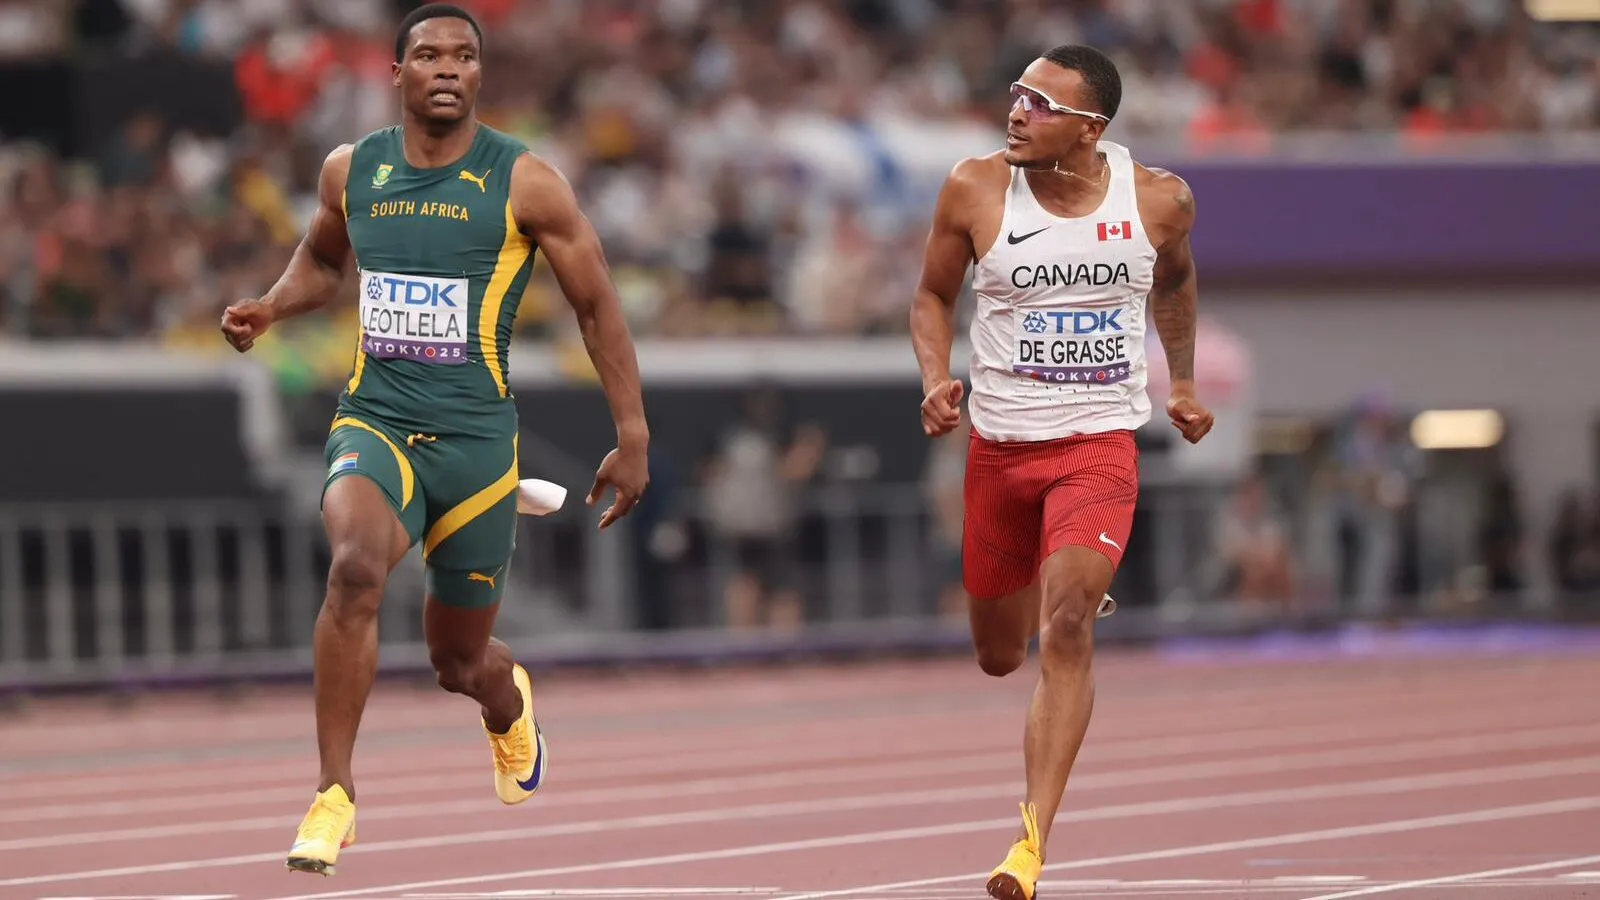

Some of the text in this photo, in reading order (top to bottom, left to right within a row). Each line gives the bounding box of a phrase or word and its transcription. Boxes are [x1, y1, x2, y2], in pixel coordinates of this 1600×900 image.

[371, 201, 469, 221] SOUTH AFRICA
[1011, 263, 1130, 289] CANADA
[383, 277, 458, 307] TDK
[362, 306, 461, 338] LEOTLELA
[1046, 308, 1123, 334] TDK
[1020, 336, 1126, 364] DE GRASSE
